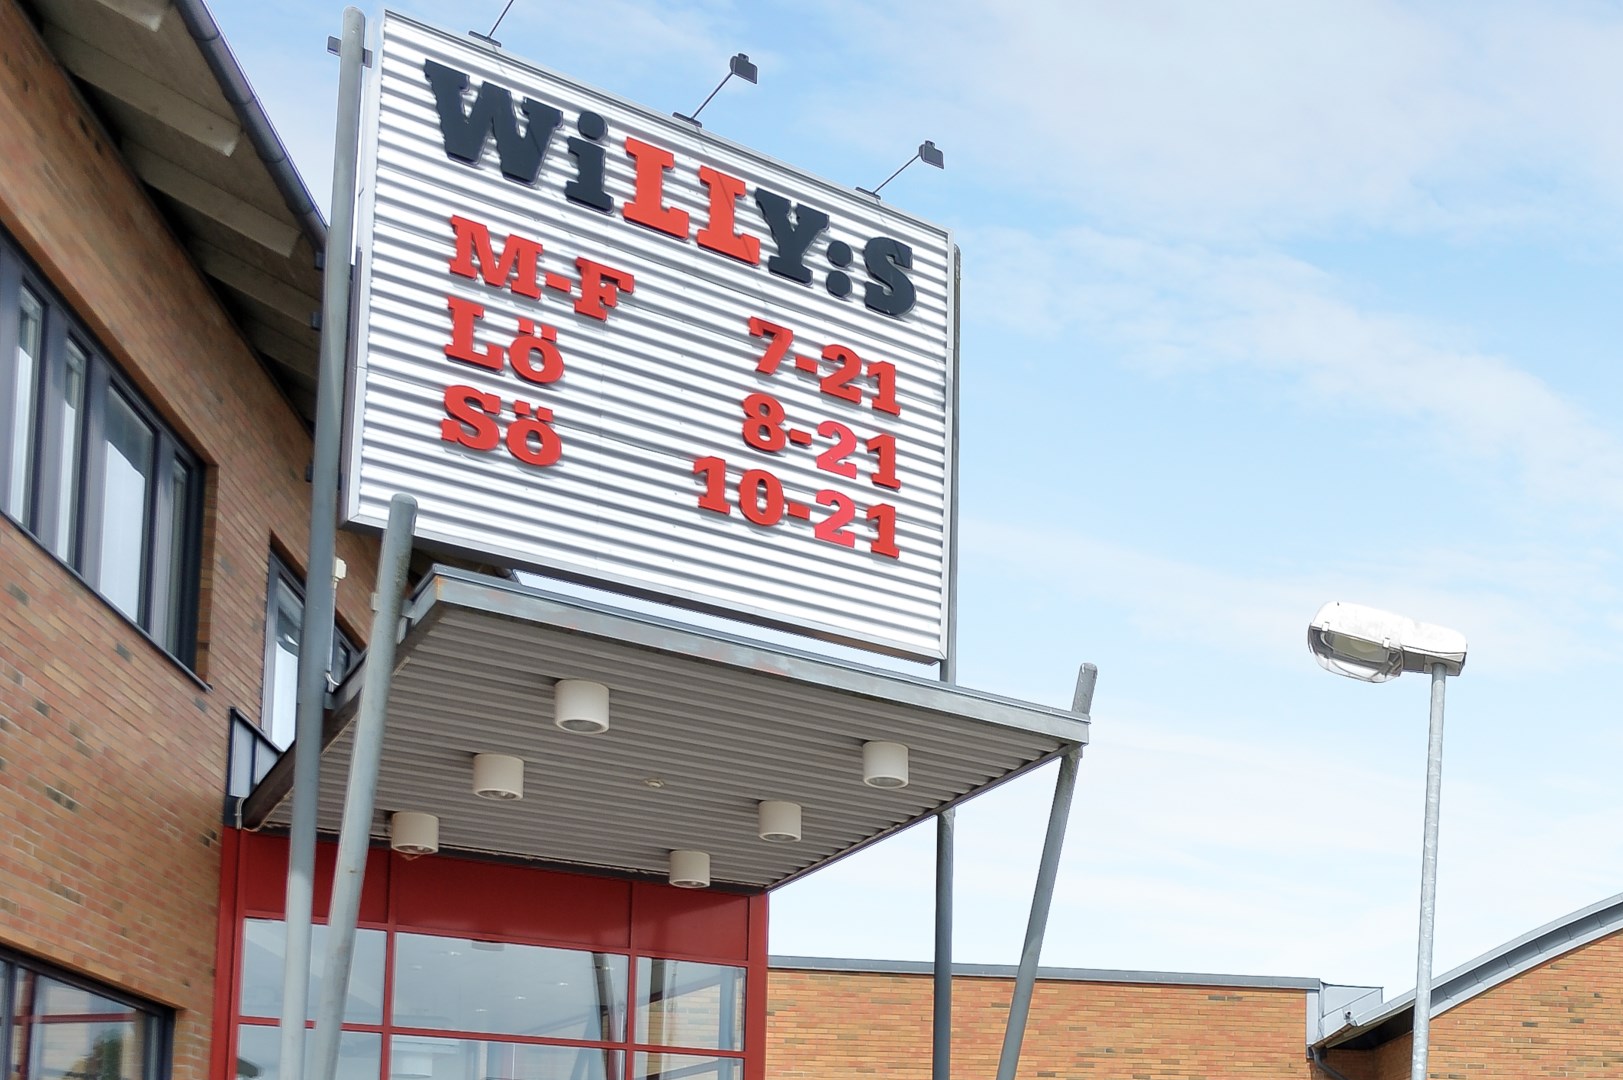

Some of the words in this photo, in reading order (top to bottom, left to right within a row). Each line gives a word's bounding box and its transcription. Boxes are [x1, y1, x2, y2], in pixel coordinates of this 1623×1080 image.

[423, 58, 917, 319] WiLLY:S
[449, 215, 635, 322] M-F
[443, 297, 566, 385] Lö
[748, 316, 901, 416] 7-21
[441, 384, 563, 467] Sö
[741, 392, 901, 490] 8-21
[693, 456, 901, 559] 10-21
